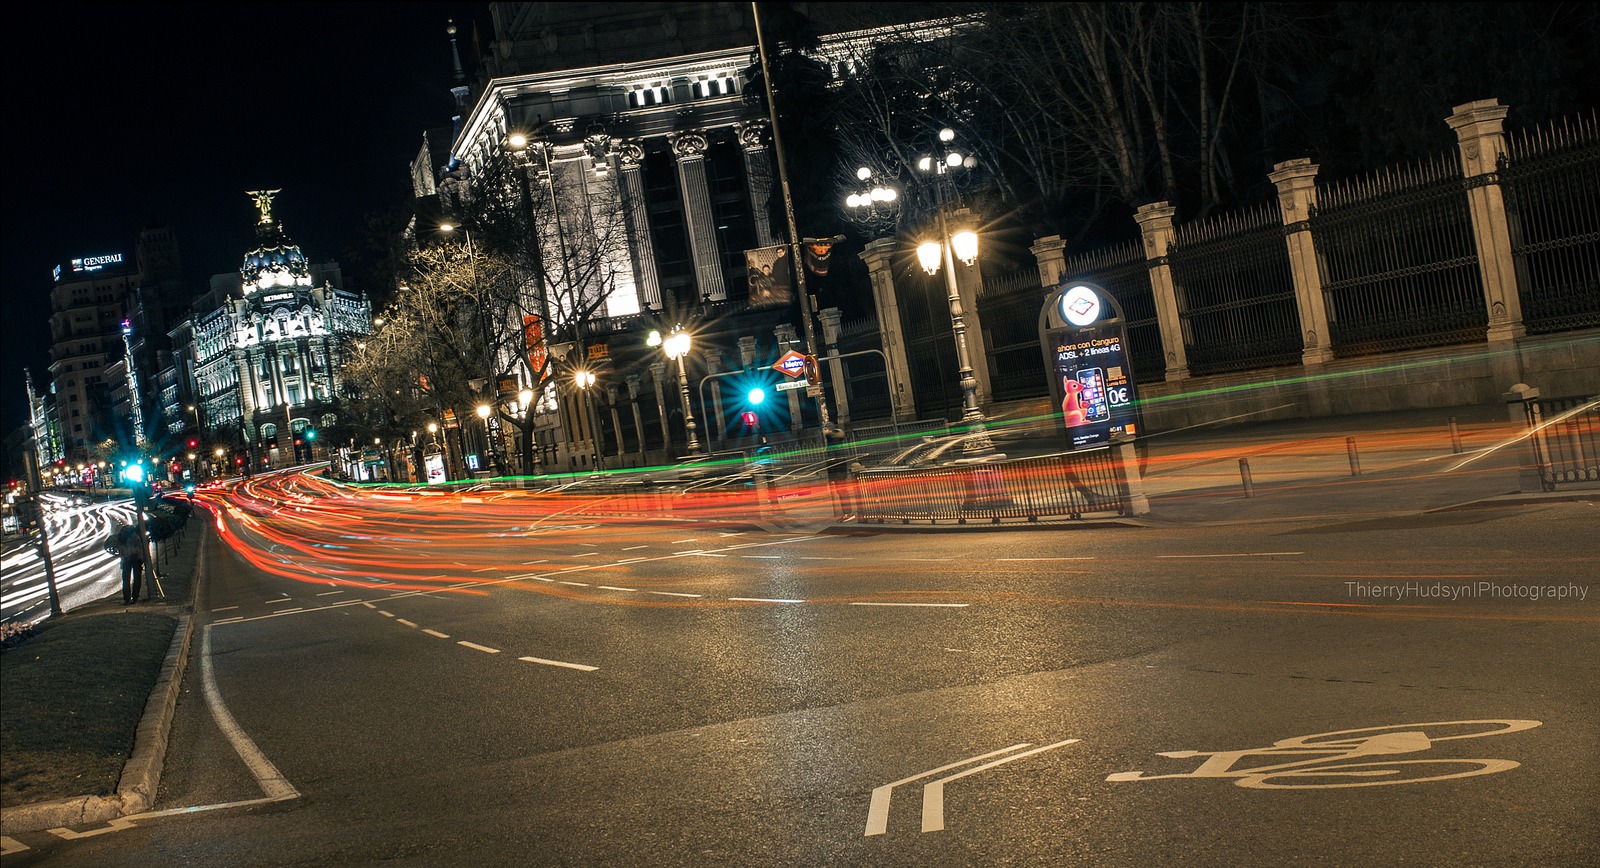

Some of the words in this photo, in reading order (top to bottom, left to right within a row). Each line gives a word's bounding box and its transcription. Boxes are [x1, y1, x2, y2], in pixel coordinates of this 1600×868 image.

[83, 254, 122, 266] GENERALI
[1057, 344, 1077, 352] ahora
[1077, 341, 1091, 349] con
[1091, 337, 1119, 347] Canguro
[1059, 351, 1079, 360] ADSL
[1109, 344, 1121, 352] 4G
[785, 360, 804, 369] Metro
[1109, 387, 1129, 405] 0€
